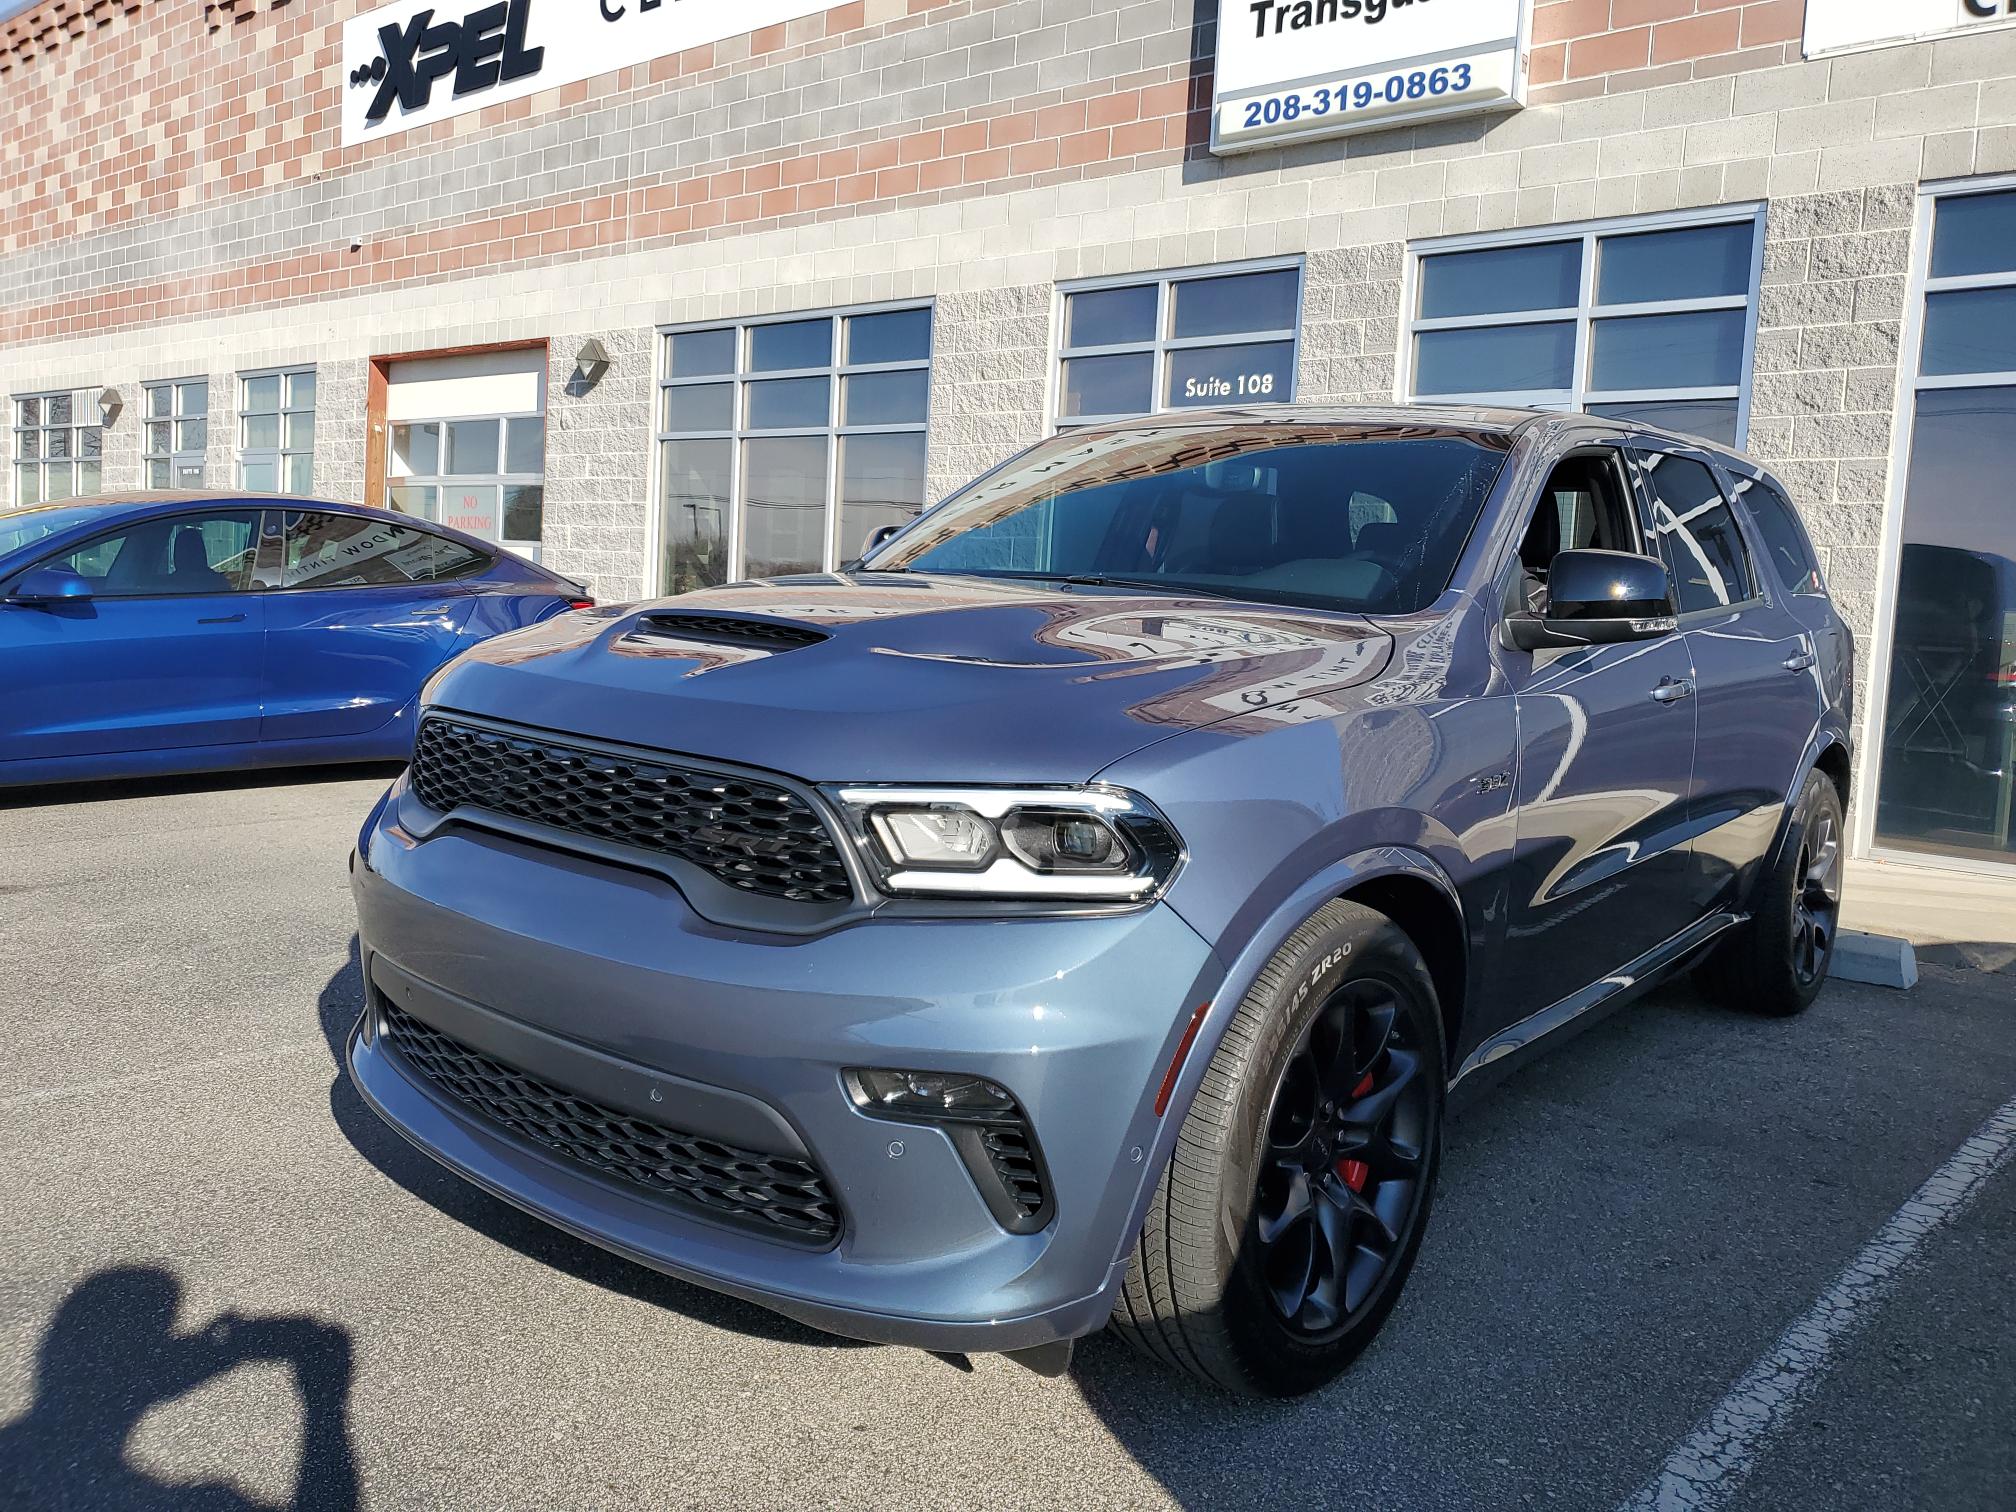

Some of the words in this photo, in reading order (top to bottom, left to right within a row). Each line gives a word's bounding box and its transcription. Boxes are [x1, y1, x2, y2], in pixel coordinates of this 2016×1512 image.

[1250, 0, 1430, 38] Transg
[365, 0, 544, 119] XPEL
[1243, 63, 1472, 128] 208-319-0863
[1185, 376, 1231, 397] Suite
[1237, 373, 1274, 395] 108
[463, 495, 478, 509] NO
[448, 515, 492, 529] PARKING
[1311, 942, 1352, 986] ZR20
